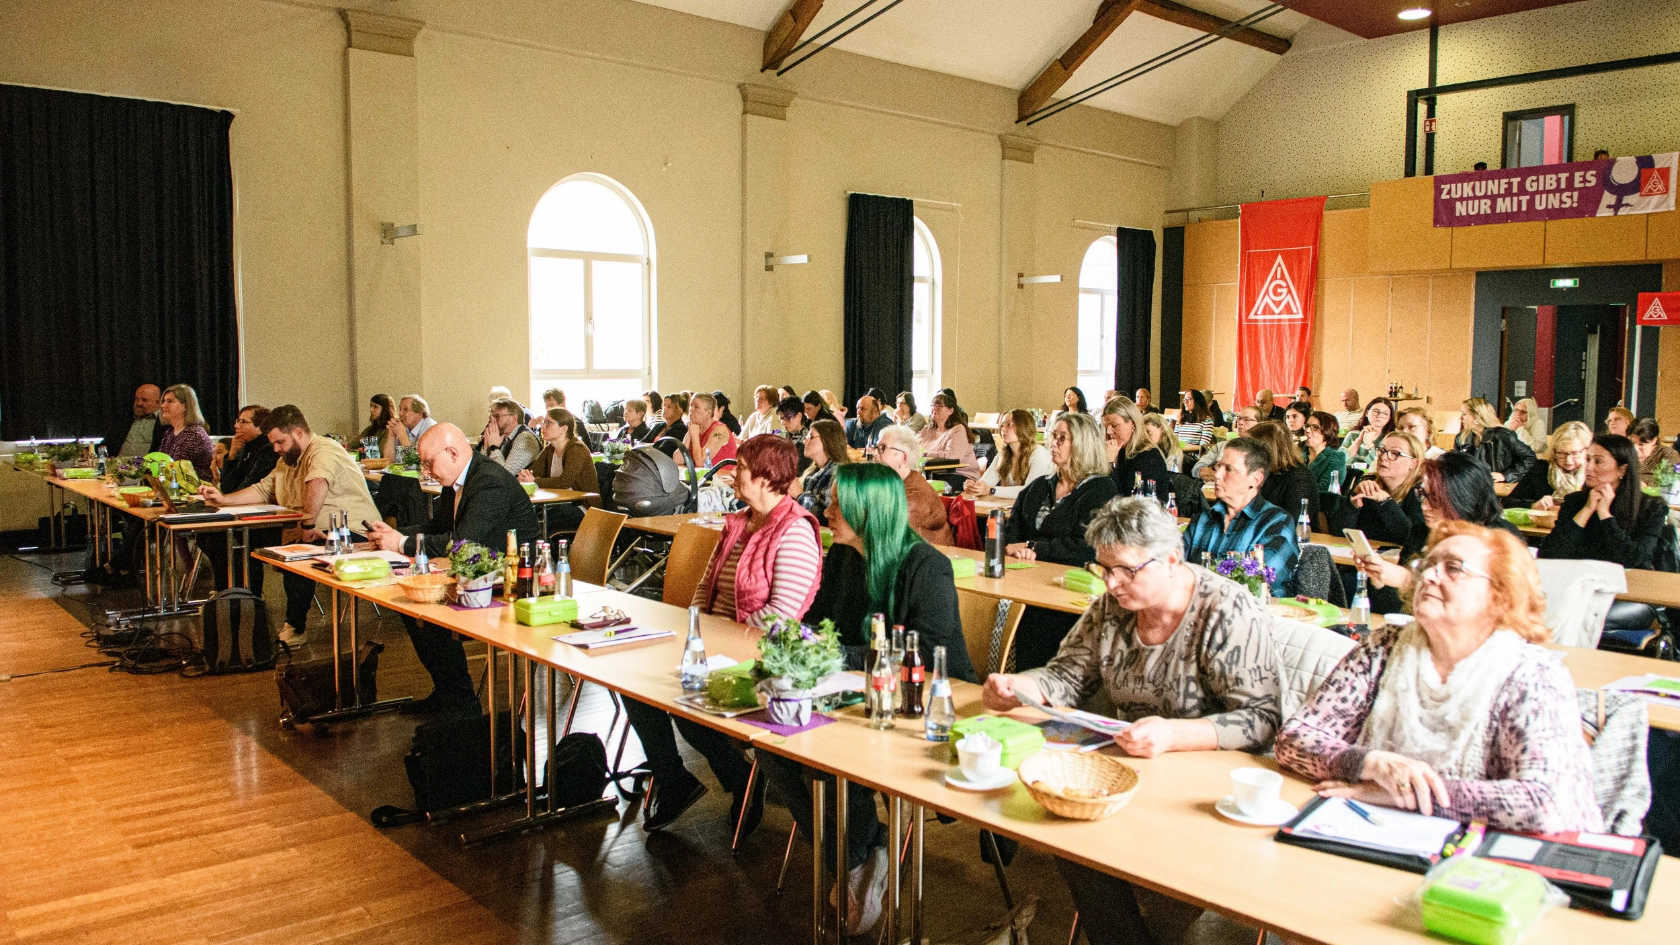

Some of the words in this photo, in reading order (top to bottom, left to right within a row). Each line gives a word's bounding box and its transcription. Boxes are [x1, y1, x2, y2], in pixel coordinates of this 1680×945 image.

[1440, 177, 1521, 200] ZUKUNFT
[1525, 172, 1570, 192] GIBT
[1573, 170, 1597, 188] ES
[1455, 200, 1491, 217] NUR
[1495, 195, 1530, 214] MIT
[1534, 191, 1579, 211] UNS!
